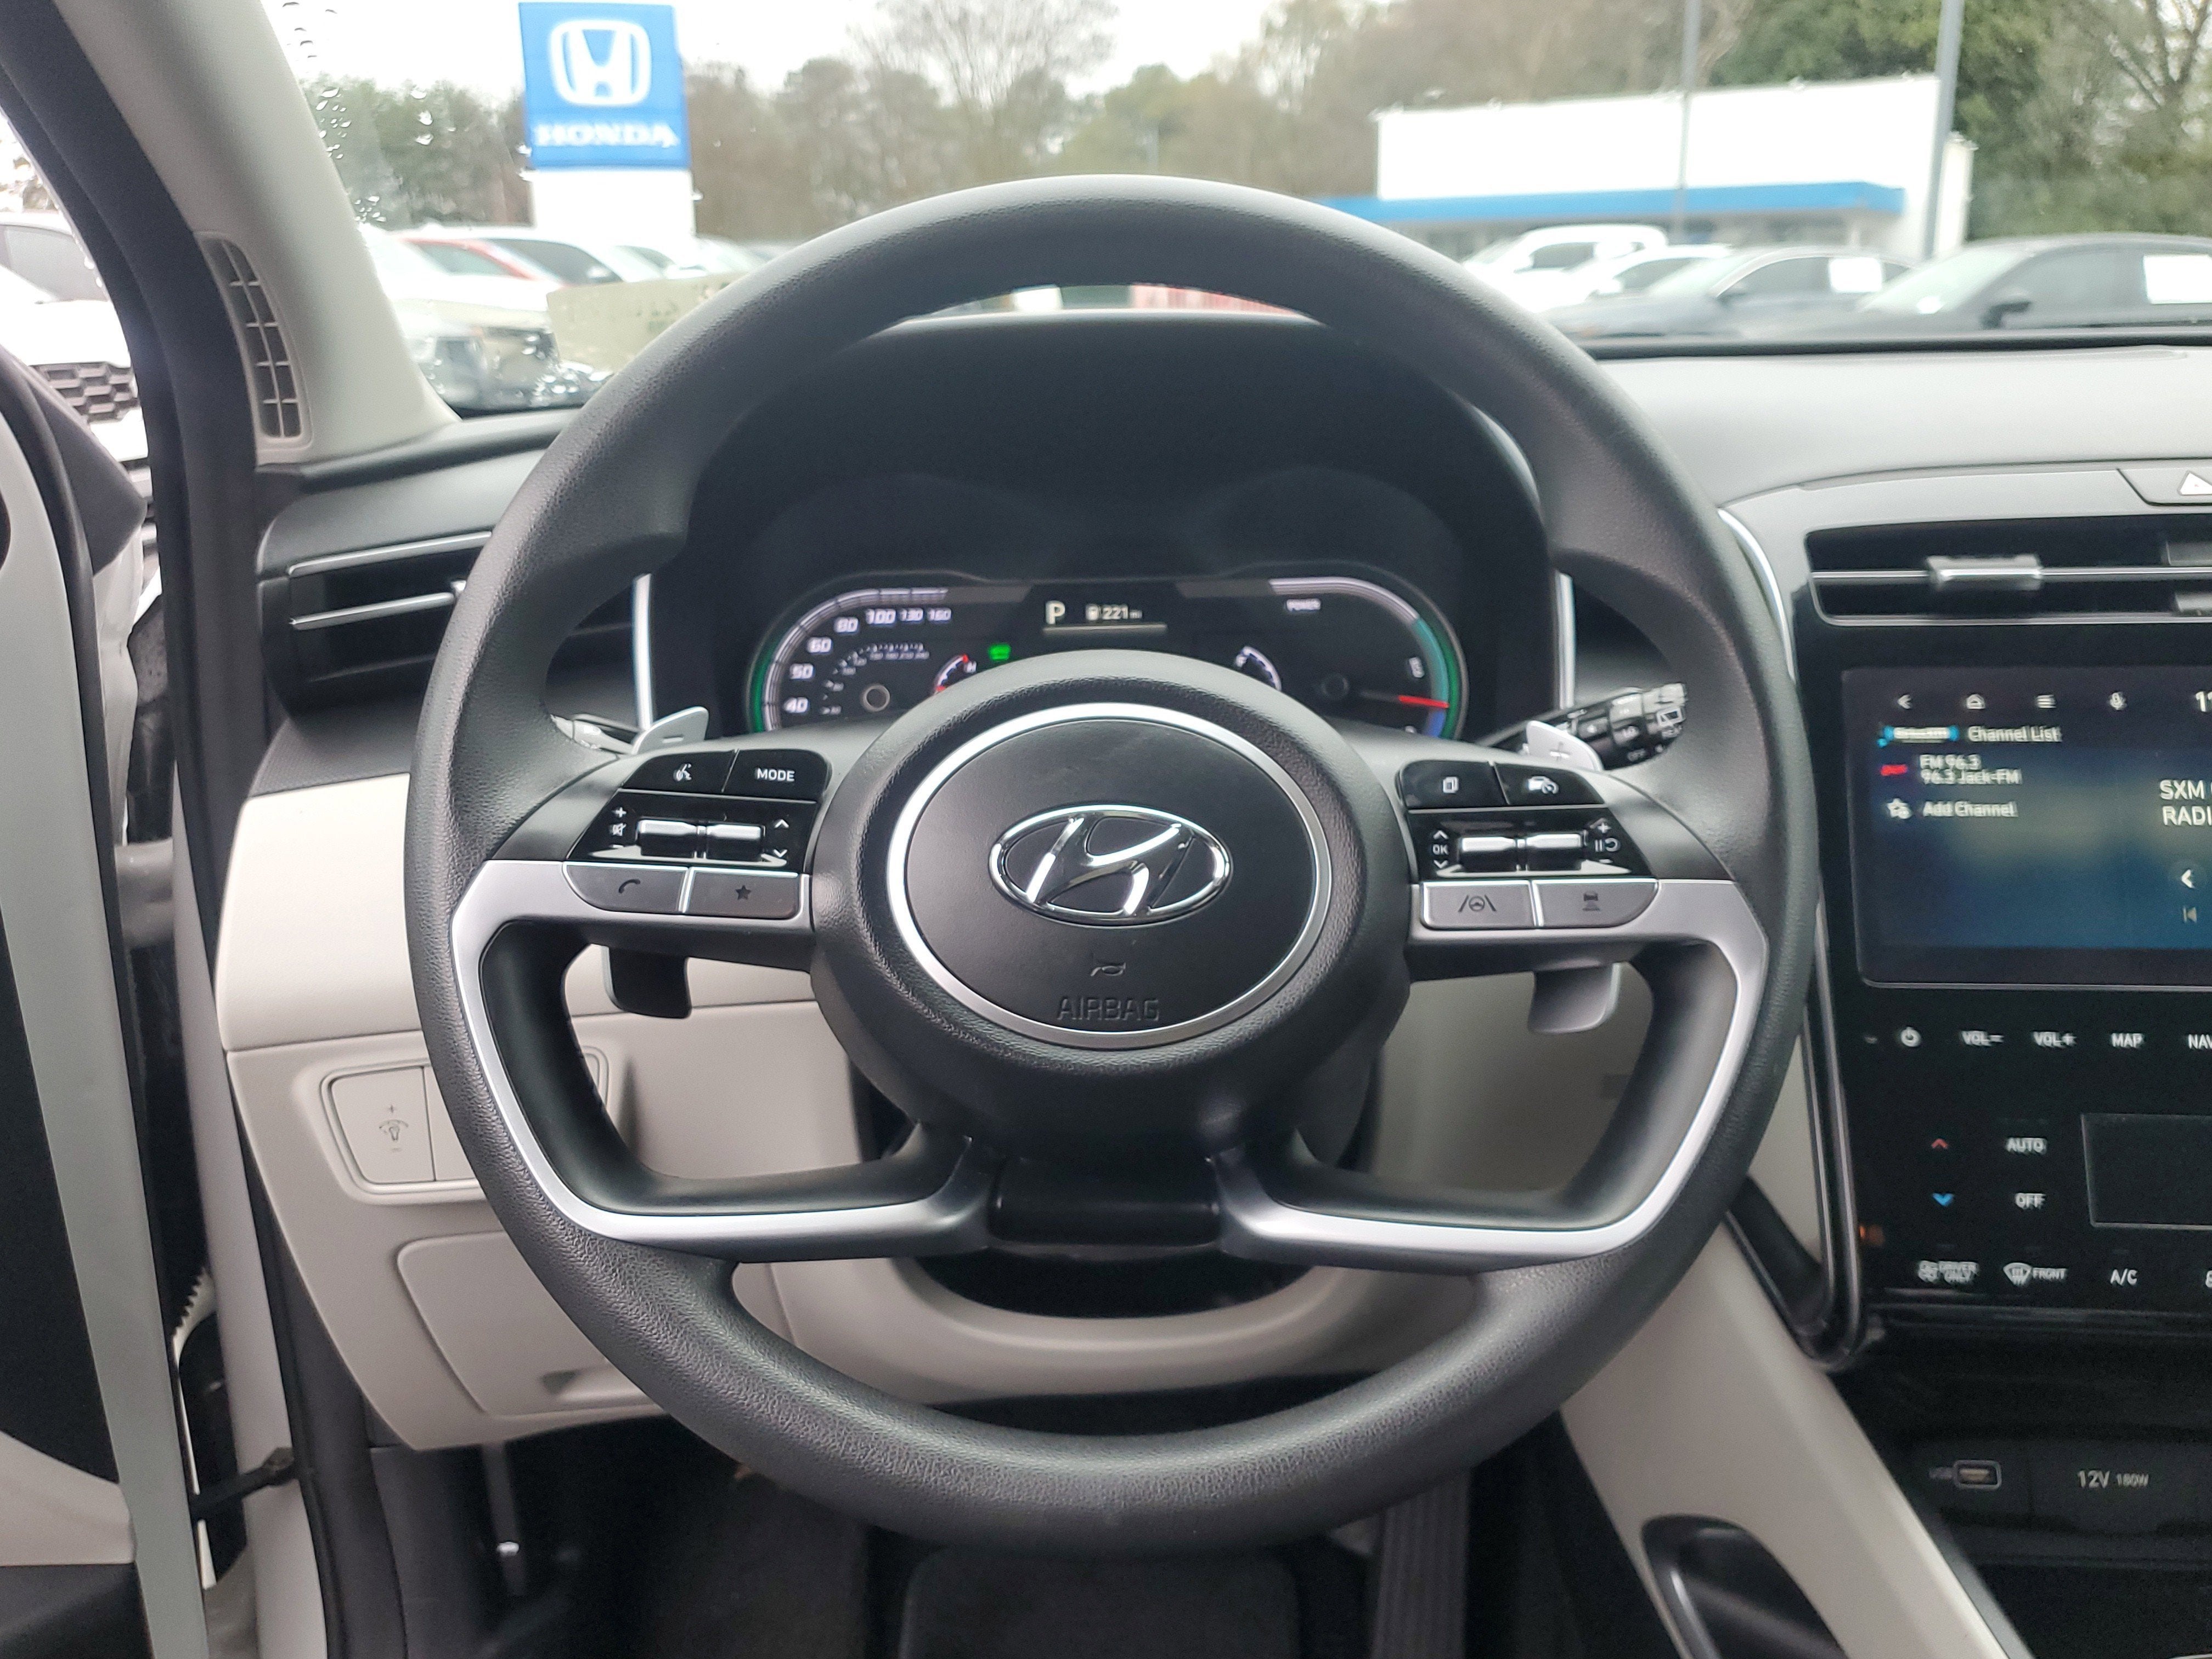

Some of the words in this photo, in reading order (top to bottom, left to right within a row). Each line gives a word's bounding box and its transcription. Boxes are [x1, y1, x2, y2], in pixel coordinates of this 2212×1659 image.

[534, 123, 679, 148] HONDA
[865, 608, 896, 624] 100
[1045, 600, 1066, 625] P
[1102, 604, 1128, 620] 221
[834, 617, 859, 634] 80
[789, 663, 814, 679] 50
[783, 697, 809, 713] 40
[1968, 726, 2028, 742] Channel
[2031, 726, 2062, 742] List
[1920, 754, 1943, 769] FM
[1945, 754, 1981, 770] 96.3
[757, 768, 795, 782] MODE
[1921, 769, 1956, 785] 96.3
[2159, 780, 2205, 800] SXM
[1923, 802, 1953, 816] Add
[1955, 802, 2018, 817] Channel
[1432, 844, 1449, 855] OK
[1057, 996, 1160, 1022] AIRBAG
[2111, 1033, 2144, 1048] MAP
[2006, 1138, 2047, 1154] AUTO
[2015, 1193, 2046, 1209] OFF
[2033, 1268, 2067, 1280] FRONT
[2110, 1269, 2138, 1285] A/C
[2077, 1470, 2111, 1489] 12V
